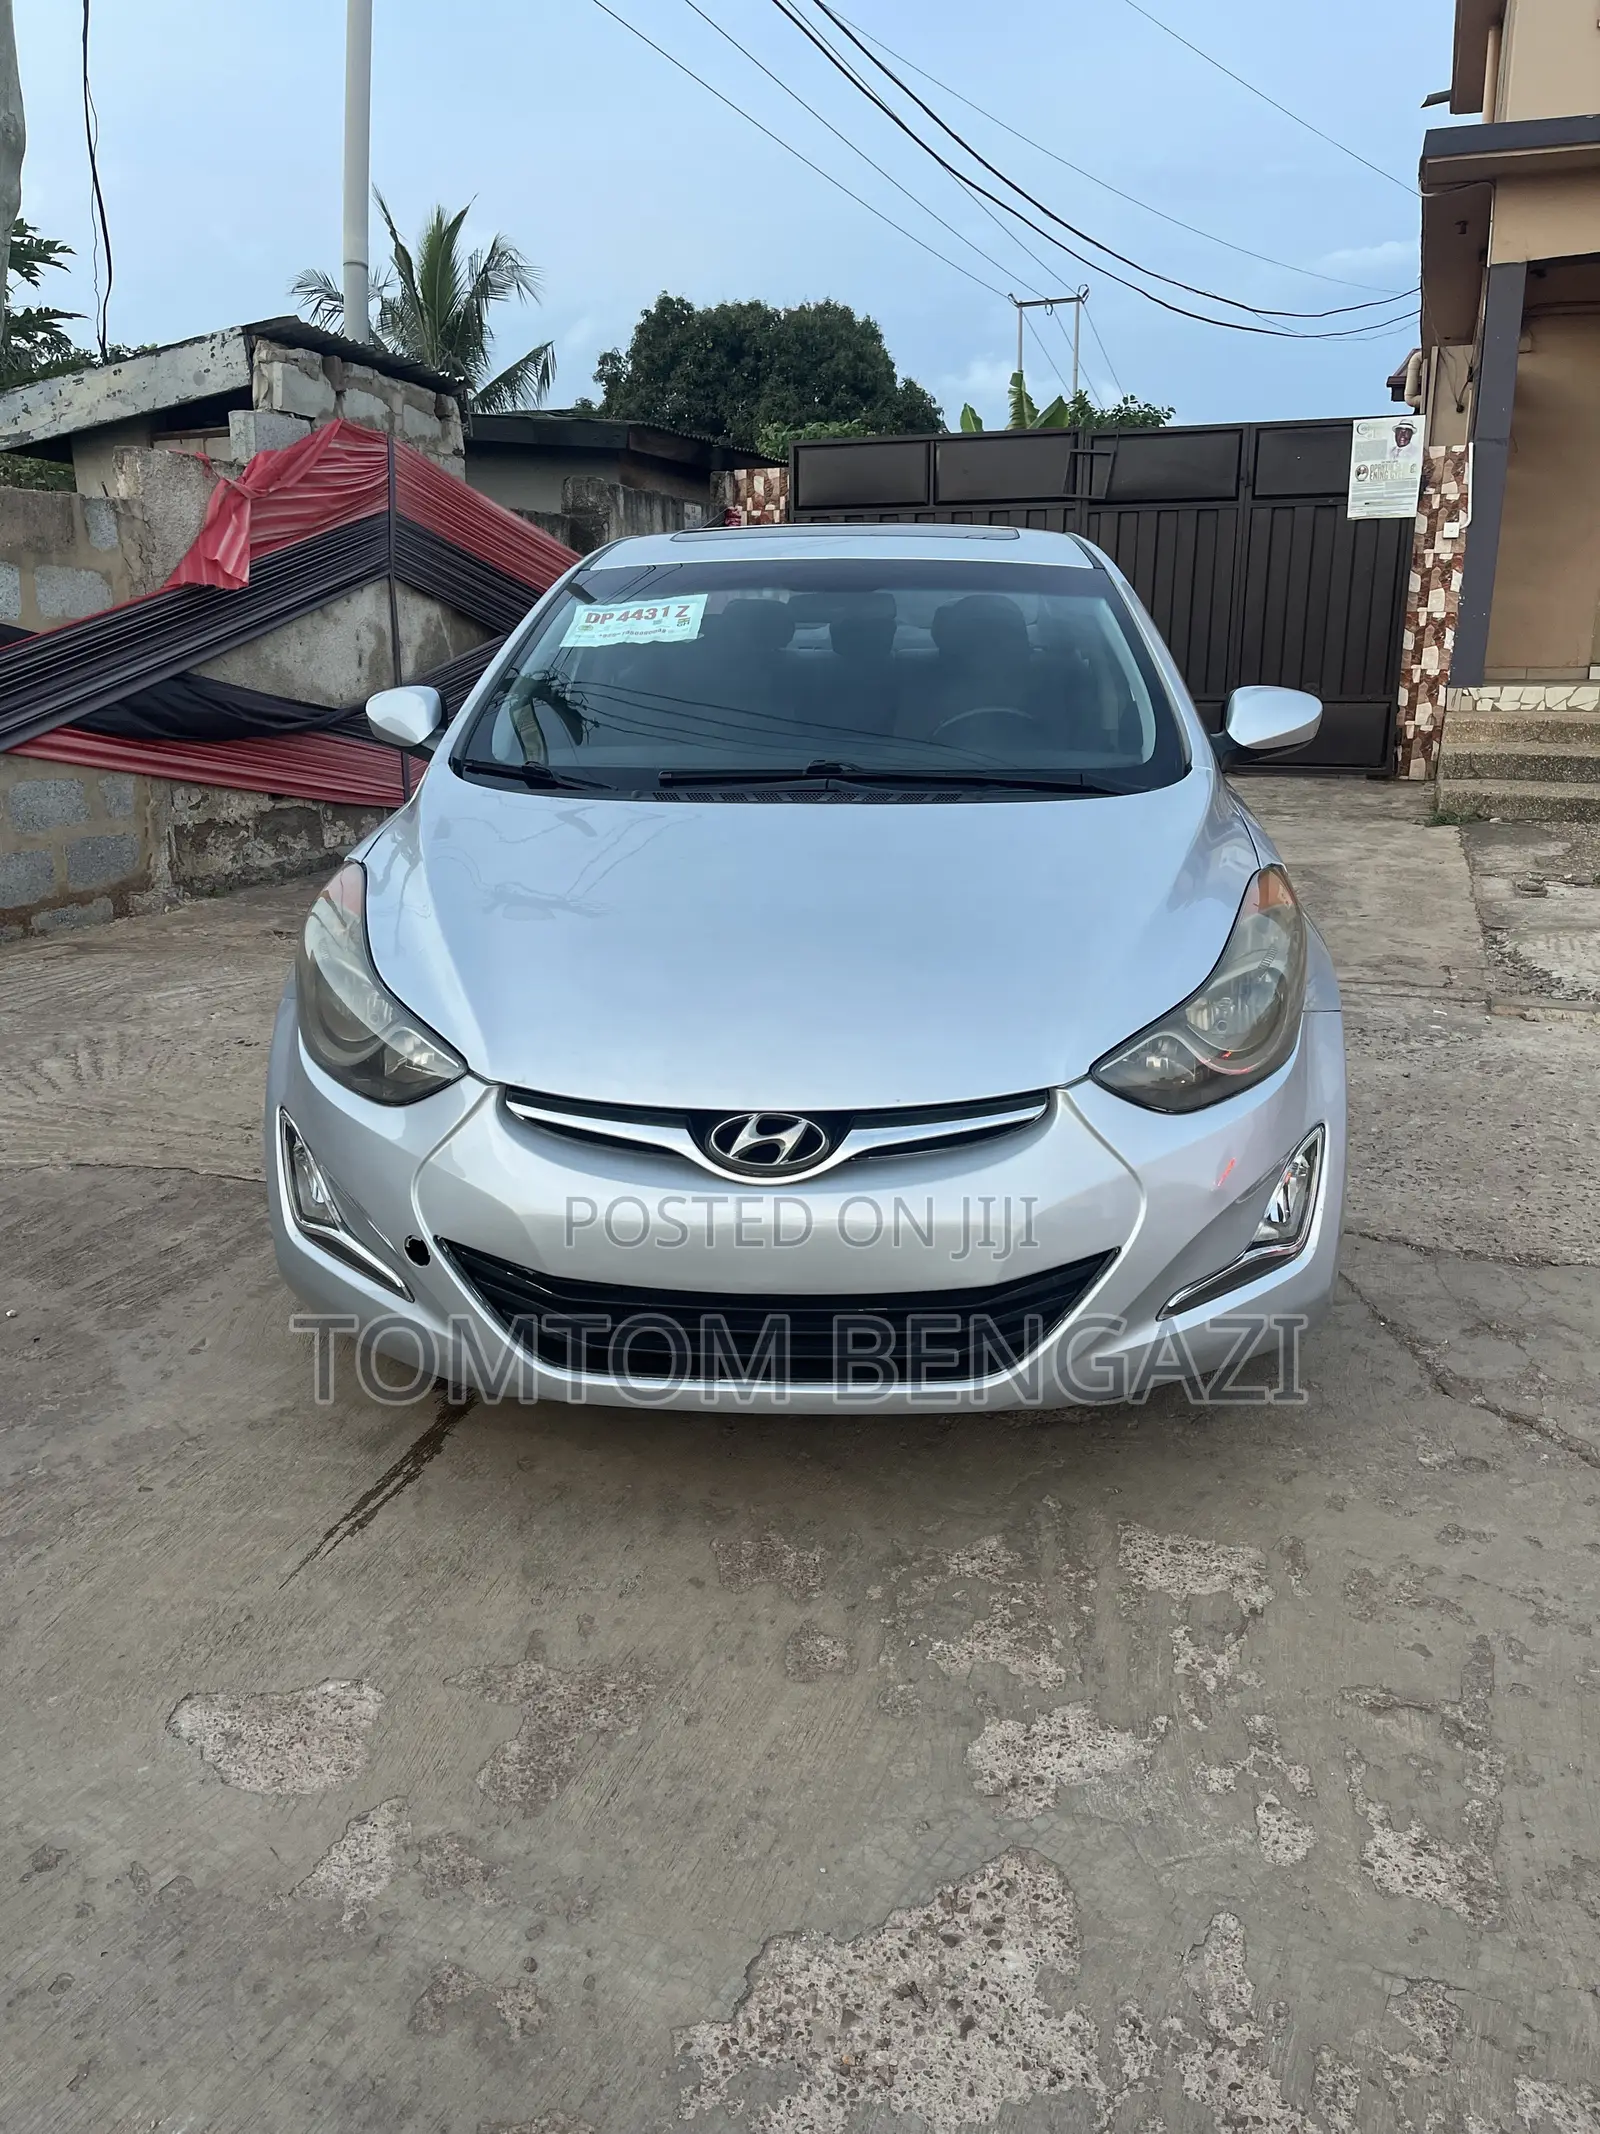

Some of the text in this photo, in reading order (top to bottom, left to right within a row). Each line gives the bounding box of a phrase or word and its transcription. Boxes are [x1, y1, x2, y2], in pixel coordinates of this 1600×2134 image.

[585, 605, 690, 625] DP 4431 Z
